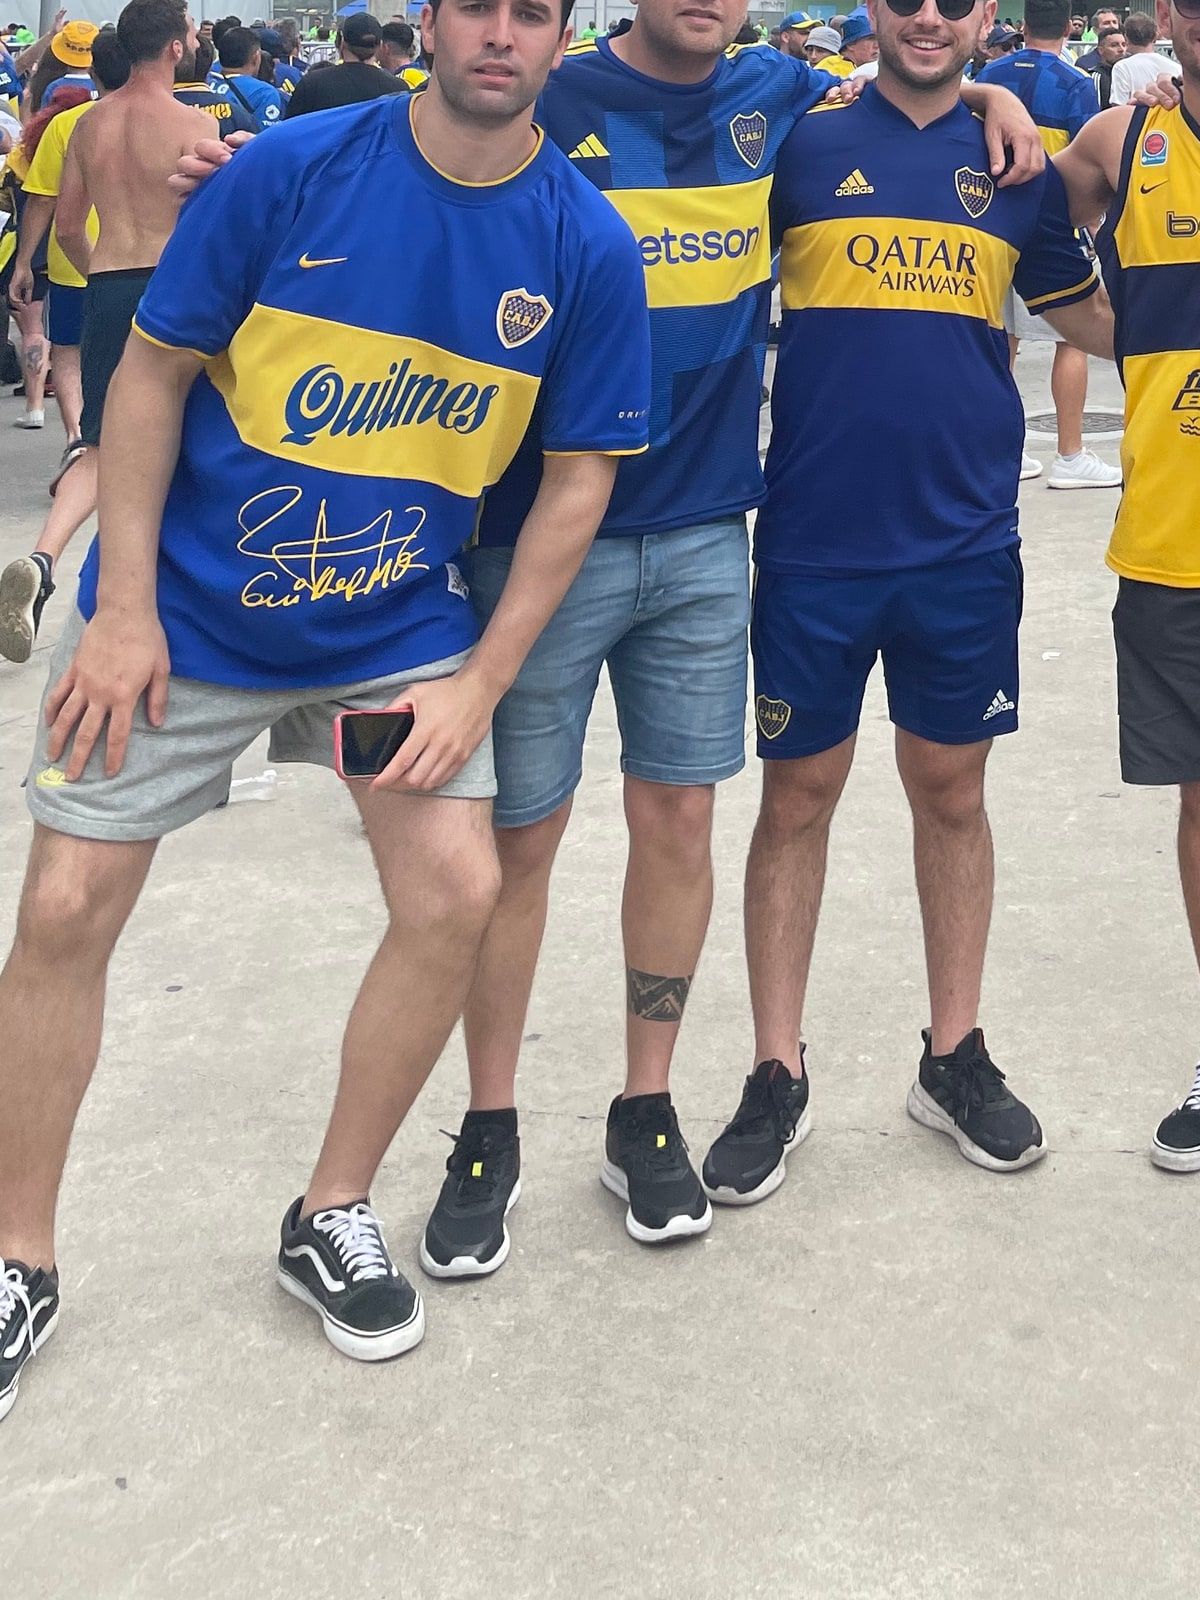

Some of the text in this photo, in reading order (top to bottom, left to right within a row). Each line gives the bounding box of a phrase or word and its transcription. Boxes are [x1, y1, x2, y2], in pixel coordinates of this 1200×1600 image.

[739, 131, 764, 143] CABJ
[835, 185, 875, 197] adidas
[960, 183, 989, 199] CABJ
[846, 234, 977, 276] QATAR
[878, 270, 977, 298] AIRWAYS
[504, 310, 540, 328] CABJ
[279, 358, 500, 446] Quilmes
[759, 708, 785, 722] CABJ
[982, 700, 1015, 721] adidas
